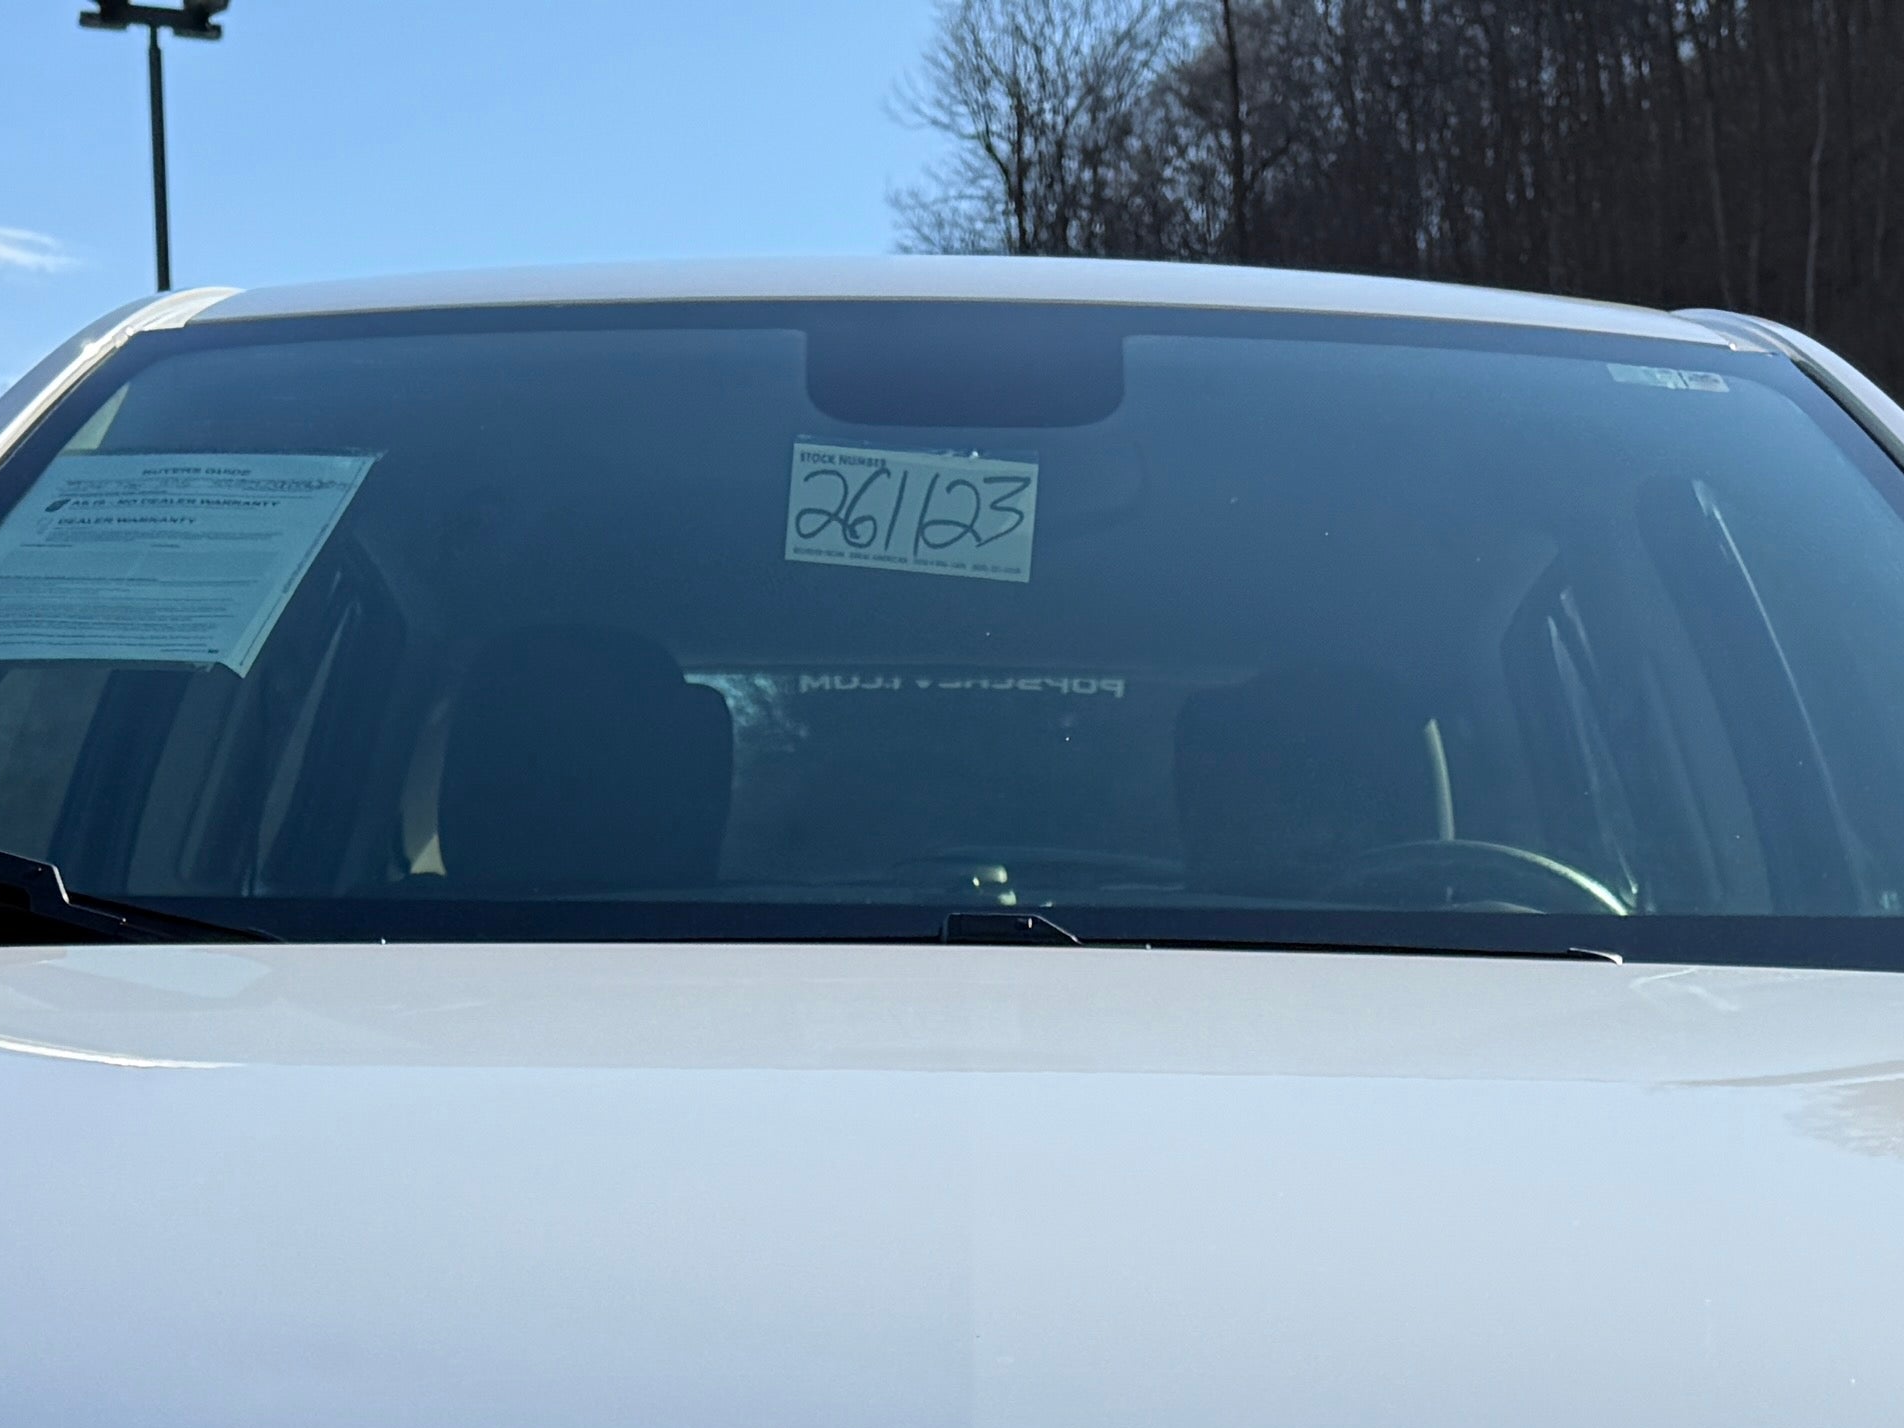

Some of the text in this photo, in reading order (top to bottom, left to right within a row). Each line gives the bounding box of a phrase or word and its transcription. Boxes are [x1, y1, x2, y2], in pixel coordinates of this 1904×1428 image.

[800, 450, 887, 468] STOCK NUMBER
[794, 467, 1032, 557] 261123
